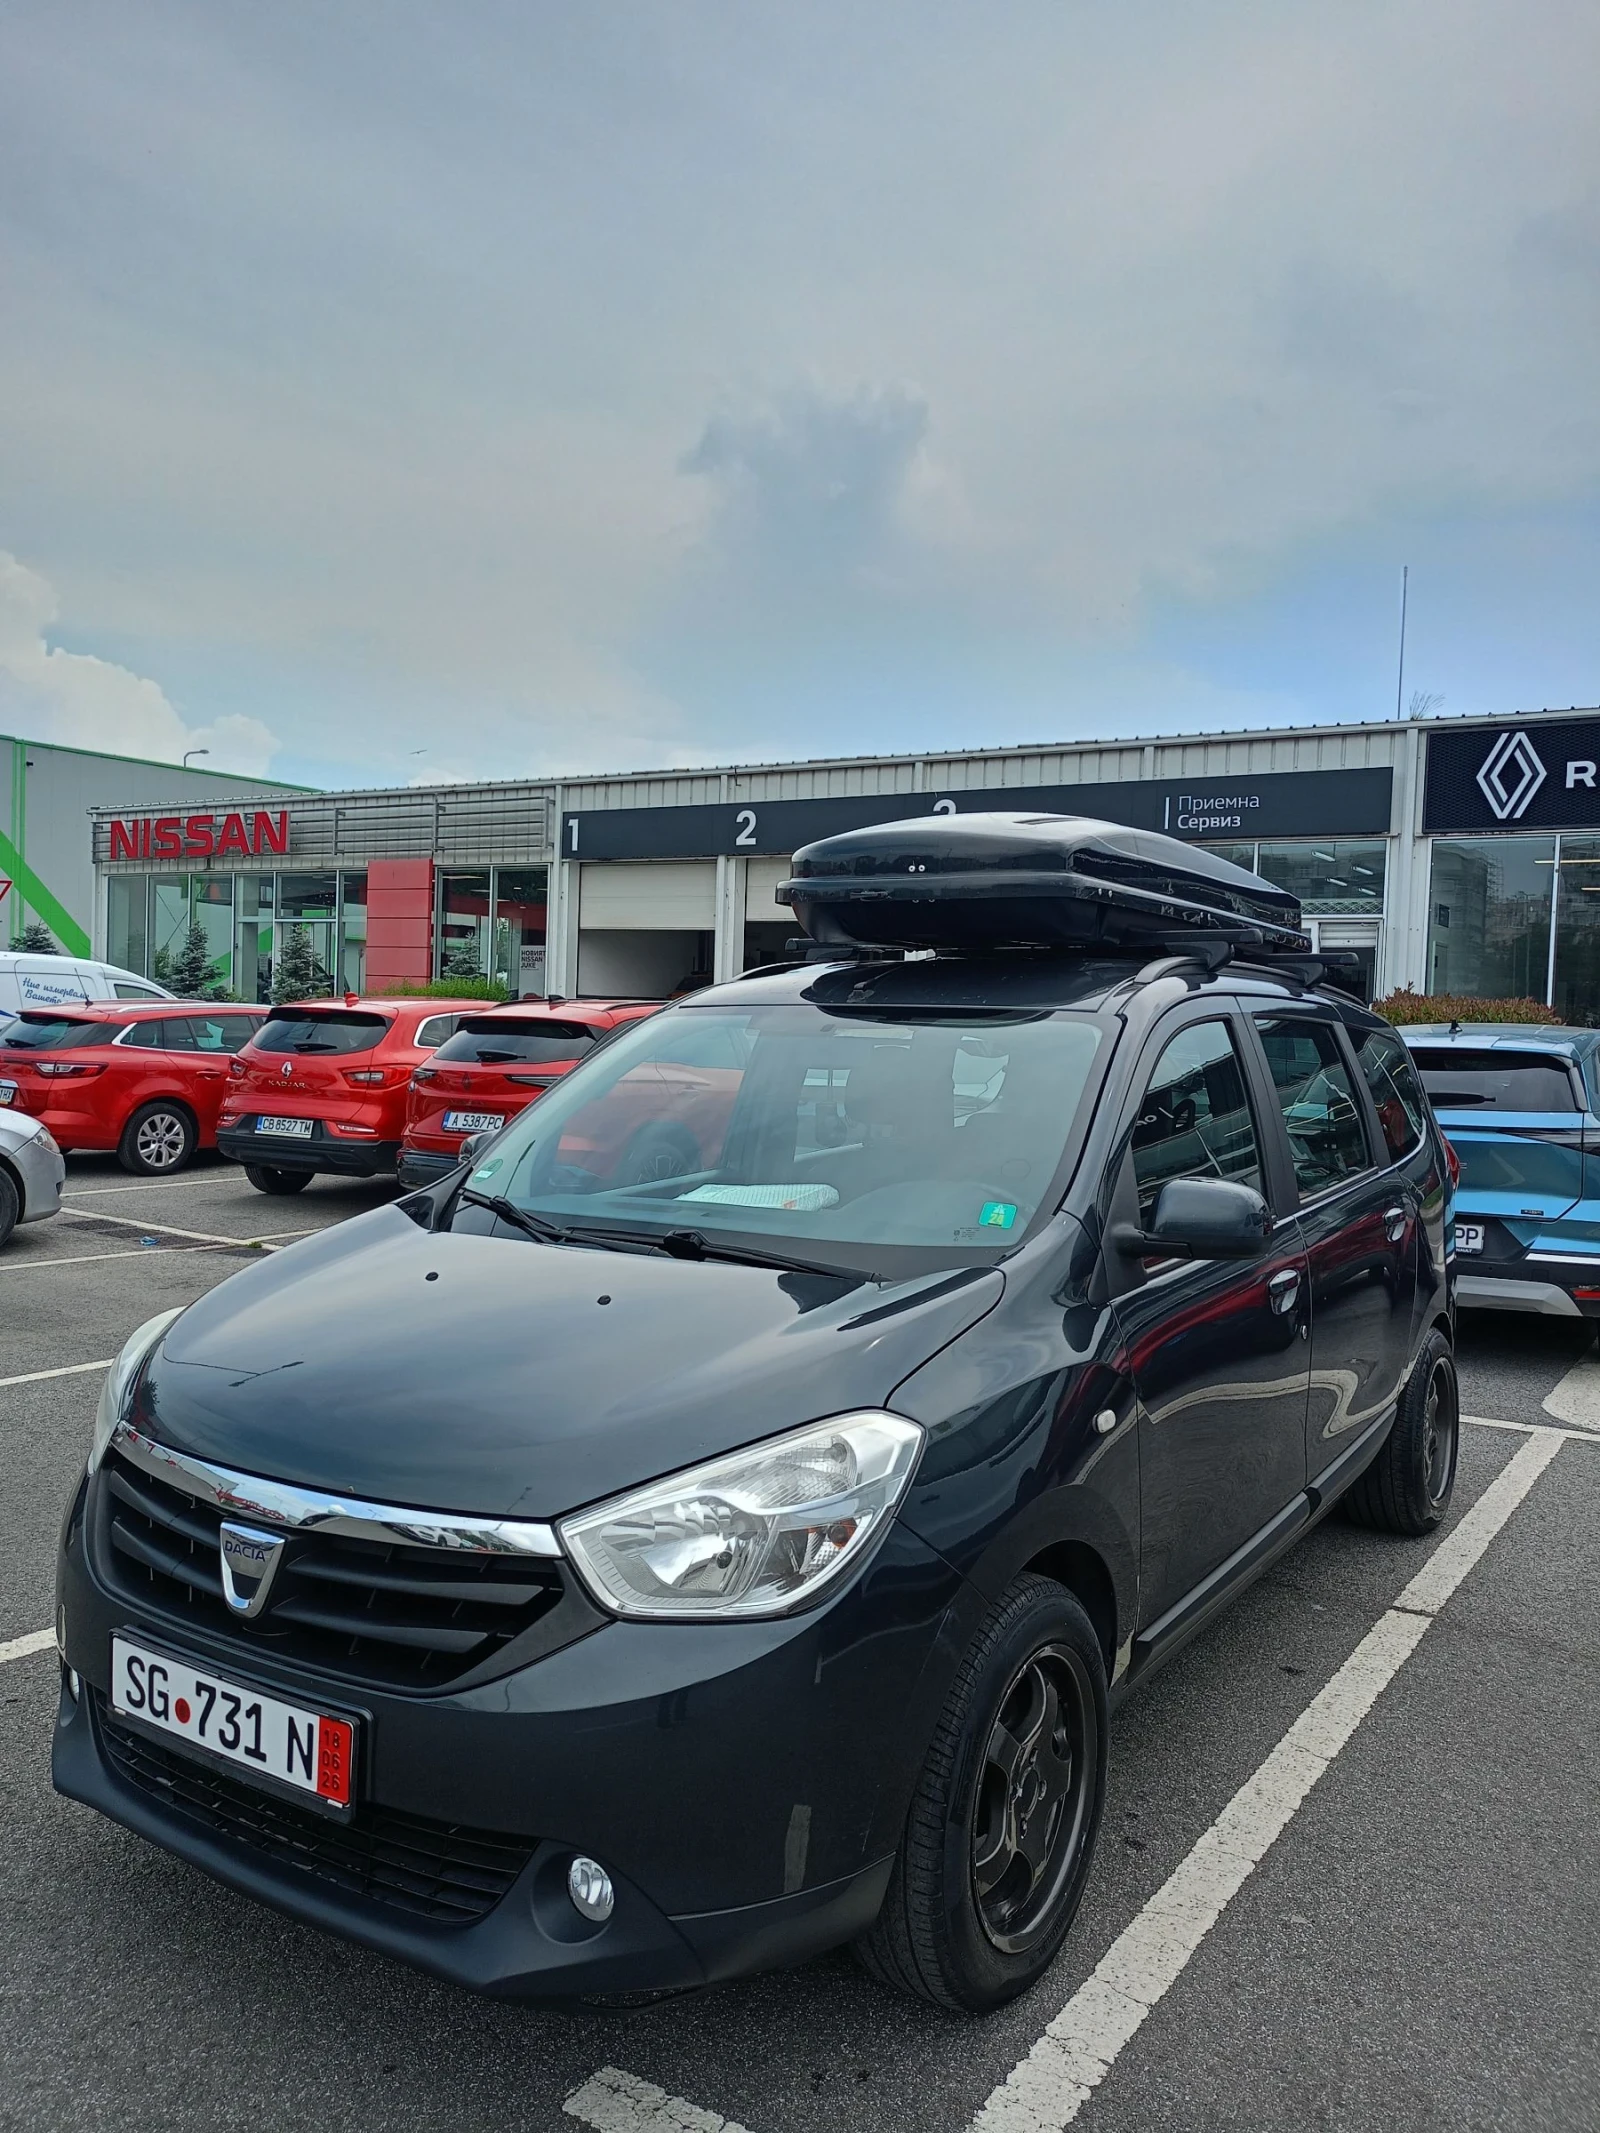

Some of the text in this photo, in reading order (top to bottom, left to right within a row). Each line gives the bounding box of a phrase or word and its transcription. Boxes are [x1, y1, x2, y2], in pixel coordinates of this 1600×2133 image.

[1179, 795, 1260, 814] Приемна
[735, 810, 757, 846] 2
[1177, 814, 1241, 832] Сервиз
[110, 810, 288, 859] NISSAN
[567, 818, 579, 852] 1
[268, 1079, 306, 1088] KADJAR
[262, 1118, 312, 1133] CB 8527 TM
[451, 1114, 502, 1130] A 5387 PC
[224, 1541, 266, 1562] DACIA
[125, 1655, 314, 1781] SG 731 N
[324, 1728, 341, 1748] 18
[322, 1749, 340, 1769] 06
[322, 1770, 340, 1790] 26
